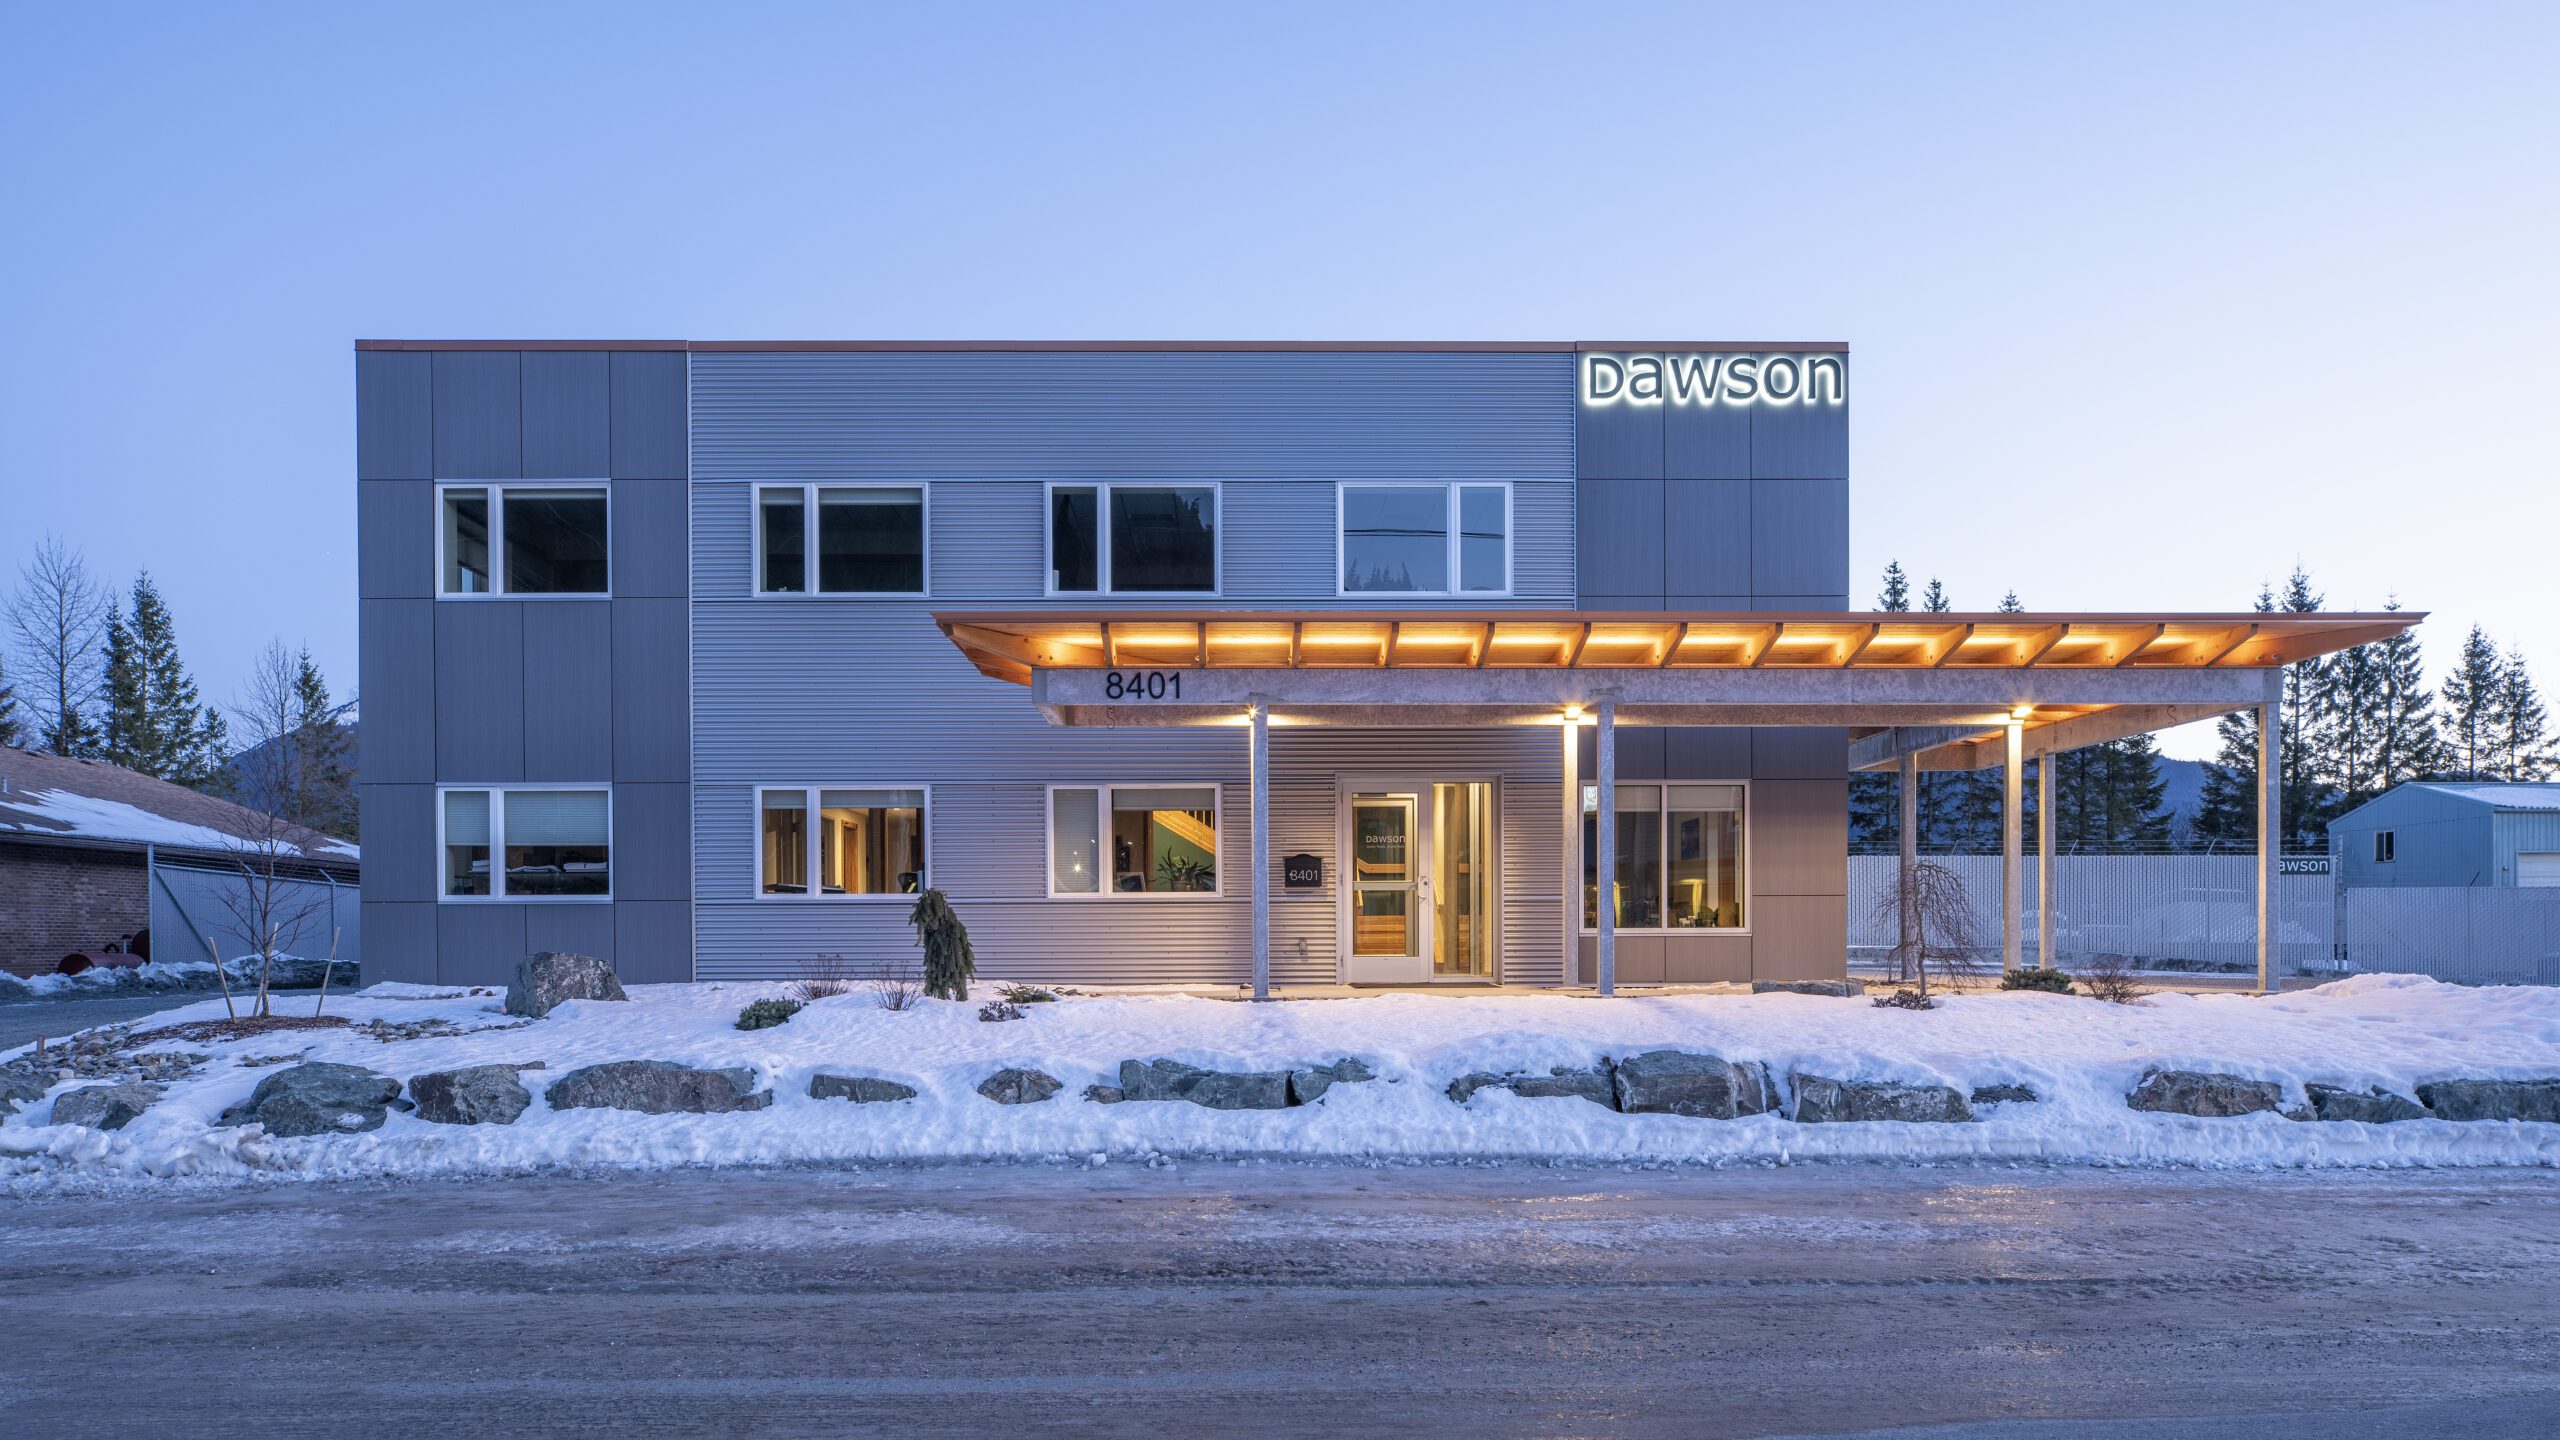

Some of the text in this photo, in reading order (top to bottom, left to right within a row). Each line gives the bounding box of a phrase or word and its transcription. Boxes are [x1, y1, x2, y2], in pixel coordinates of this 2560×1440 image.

[1589, 357, 1842, 399] Dawson
[1106, 671, 1180, 700] 8401
[1365, 835, 1406, 843] Dawson
[2279, 860, 2328, 872] awson
[1289, 869, 1318, 881] 8401
